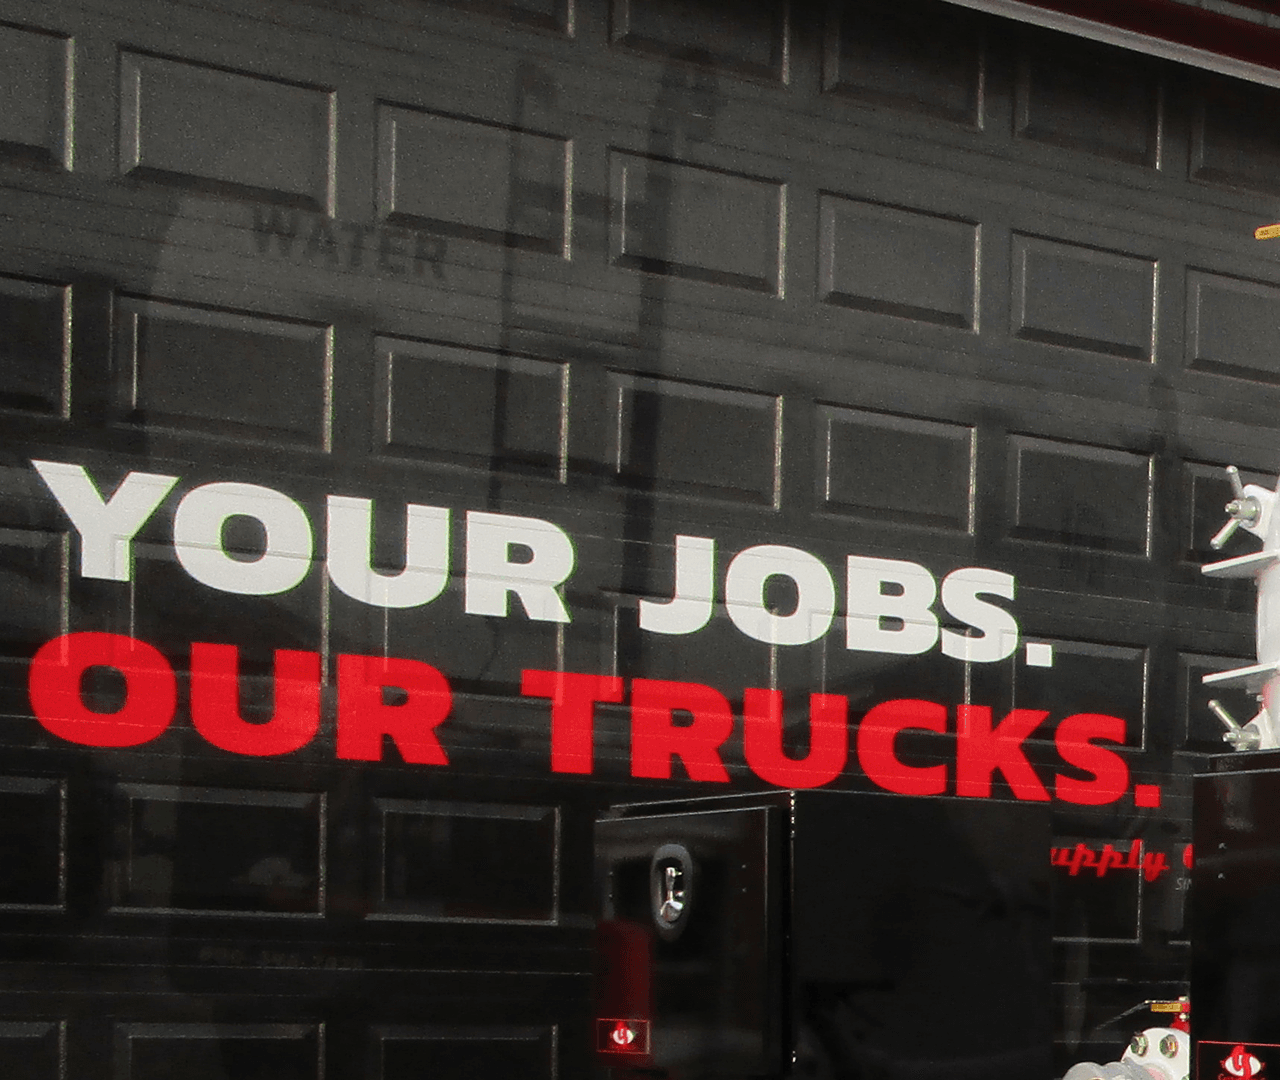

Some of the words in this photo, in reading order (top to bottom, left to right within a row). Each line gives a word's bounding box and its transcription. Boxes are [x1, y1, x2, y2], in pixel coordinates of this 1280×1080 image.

[252, 206, 448, 280] WATER
[31, 459, 575, 624] YOUR
[639, 534, 1053, 668] JOBS.
[28, 631, 453, 766] OUR
[521, 668, 1161, 808] TRUCKS.
[1050, 838, 1169, 882] upply
